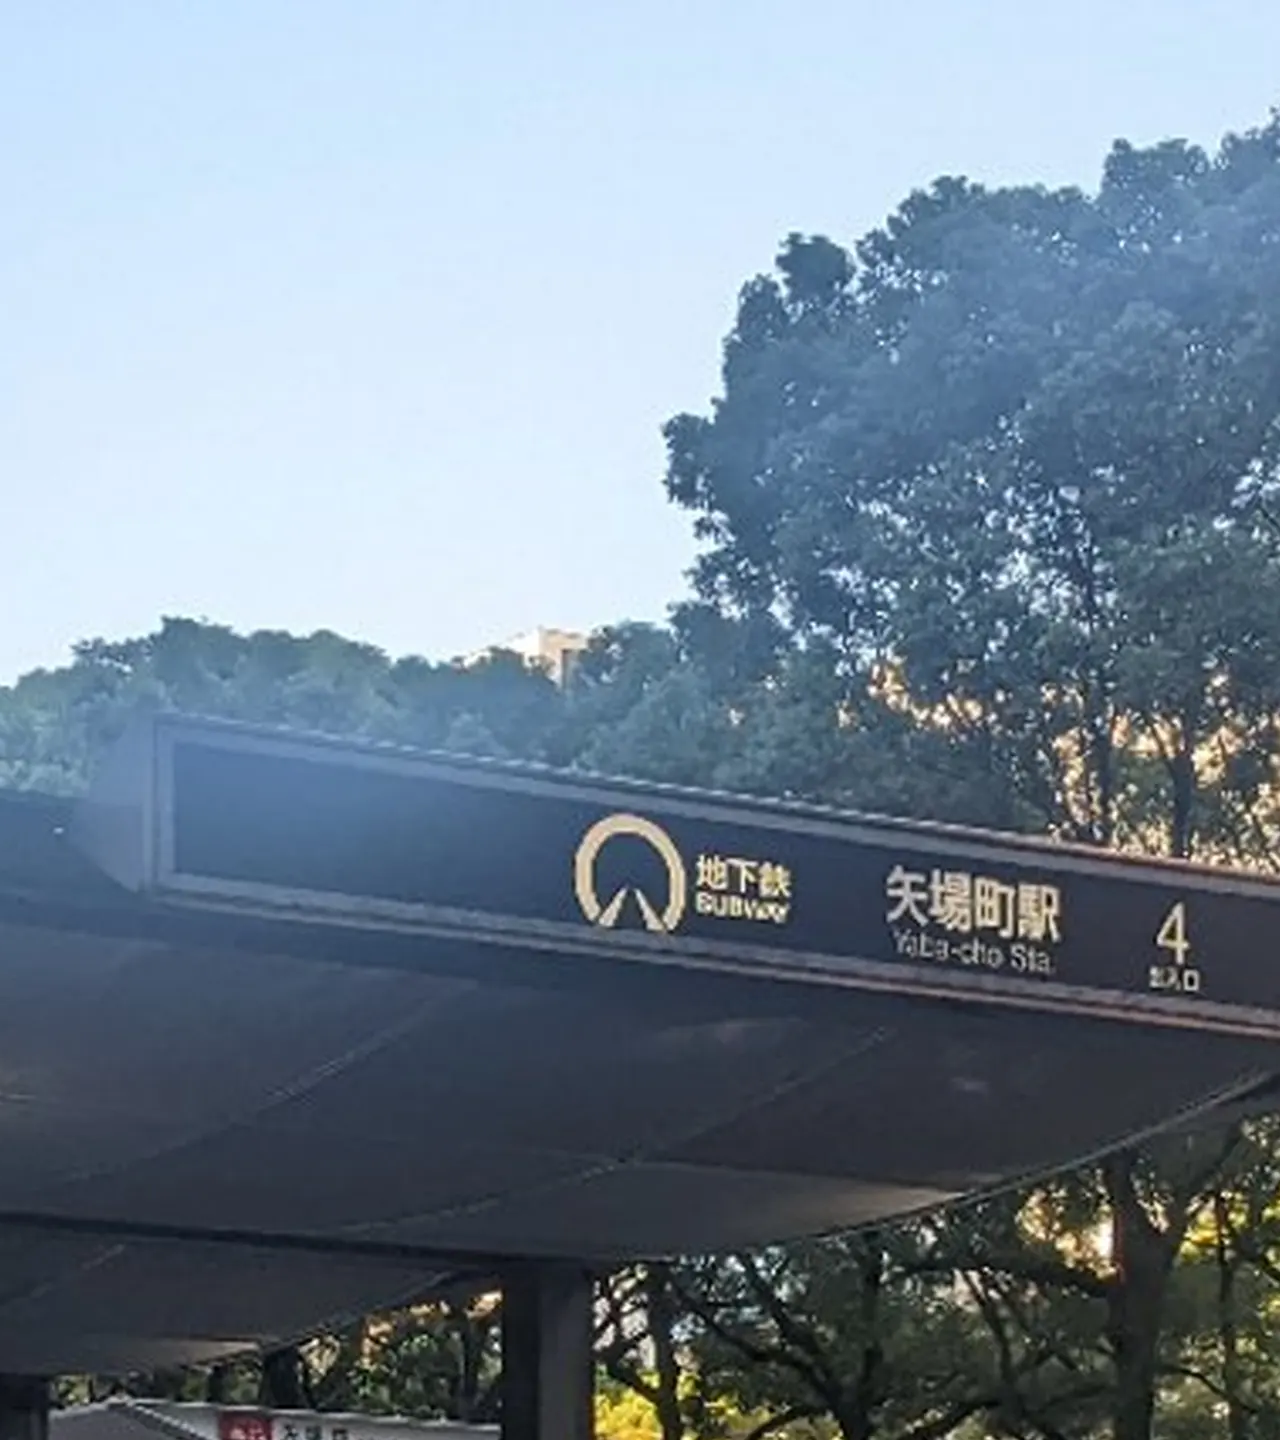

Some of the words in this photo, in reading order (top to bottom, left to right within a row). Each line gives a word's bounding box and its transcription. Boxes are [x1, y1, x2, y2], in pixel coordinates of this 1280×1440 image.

[696, 854, 791, 897] 地下鉄
[886, 864, 1060, 943] 矢場町駅
[893, 928, 1005, 968] Yaba-cho
[1010, 942, 1056, 975] Sta.
[1157, 901, 1189, 965] 4
